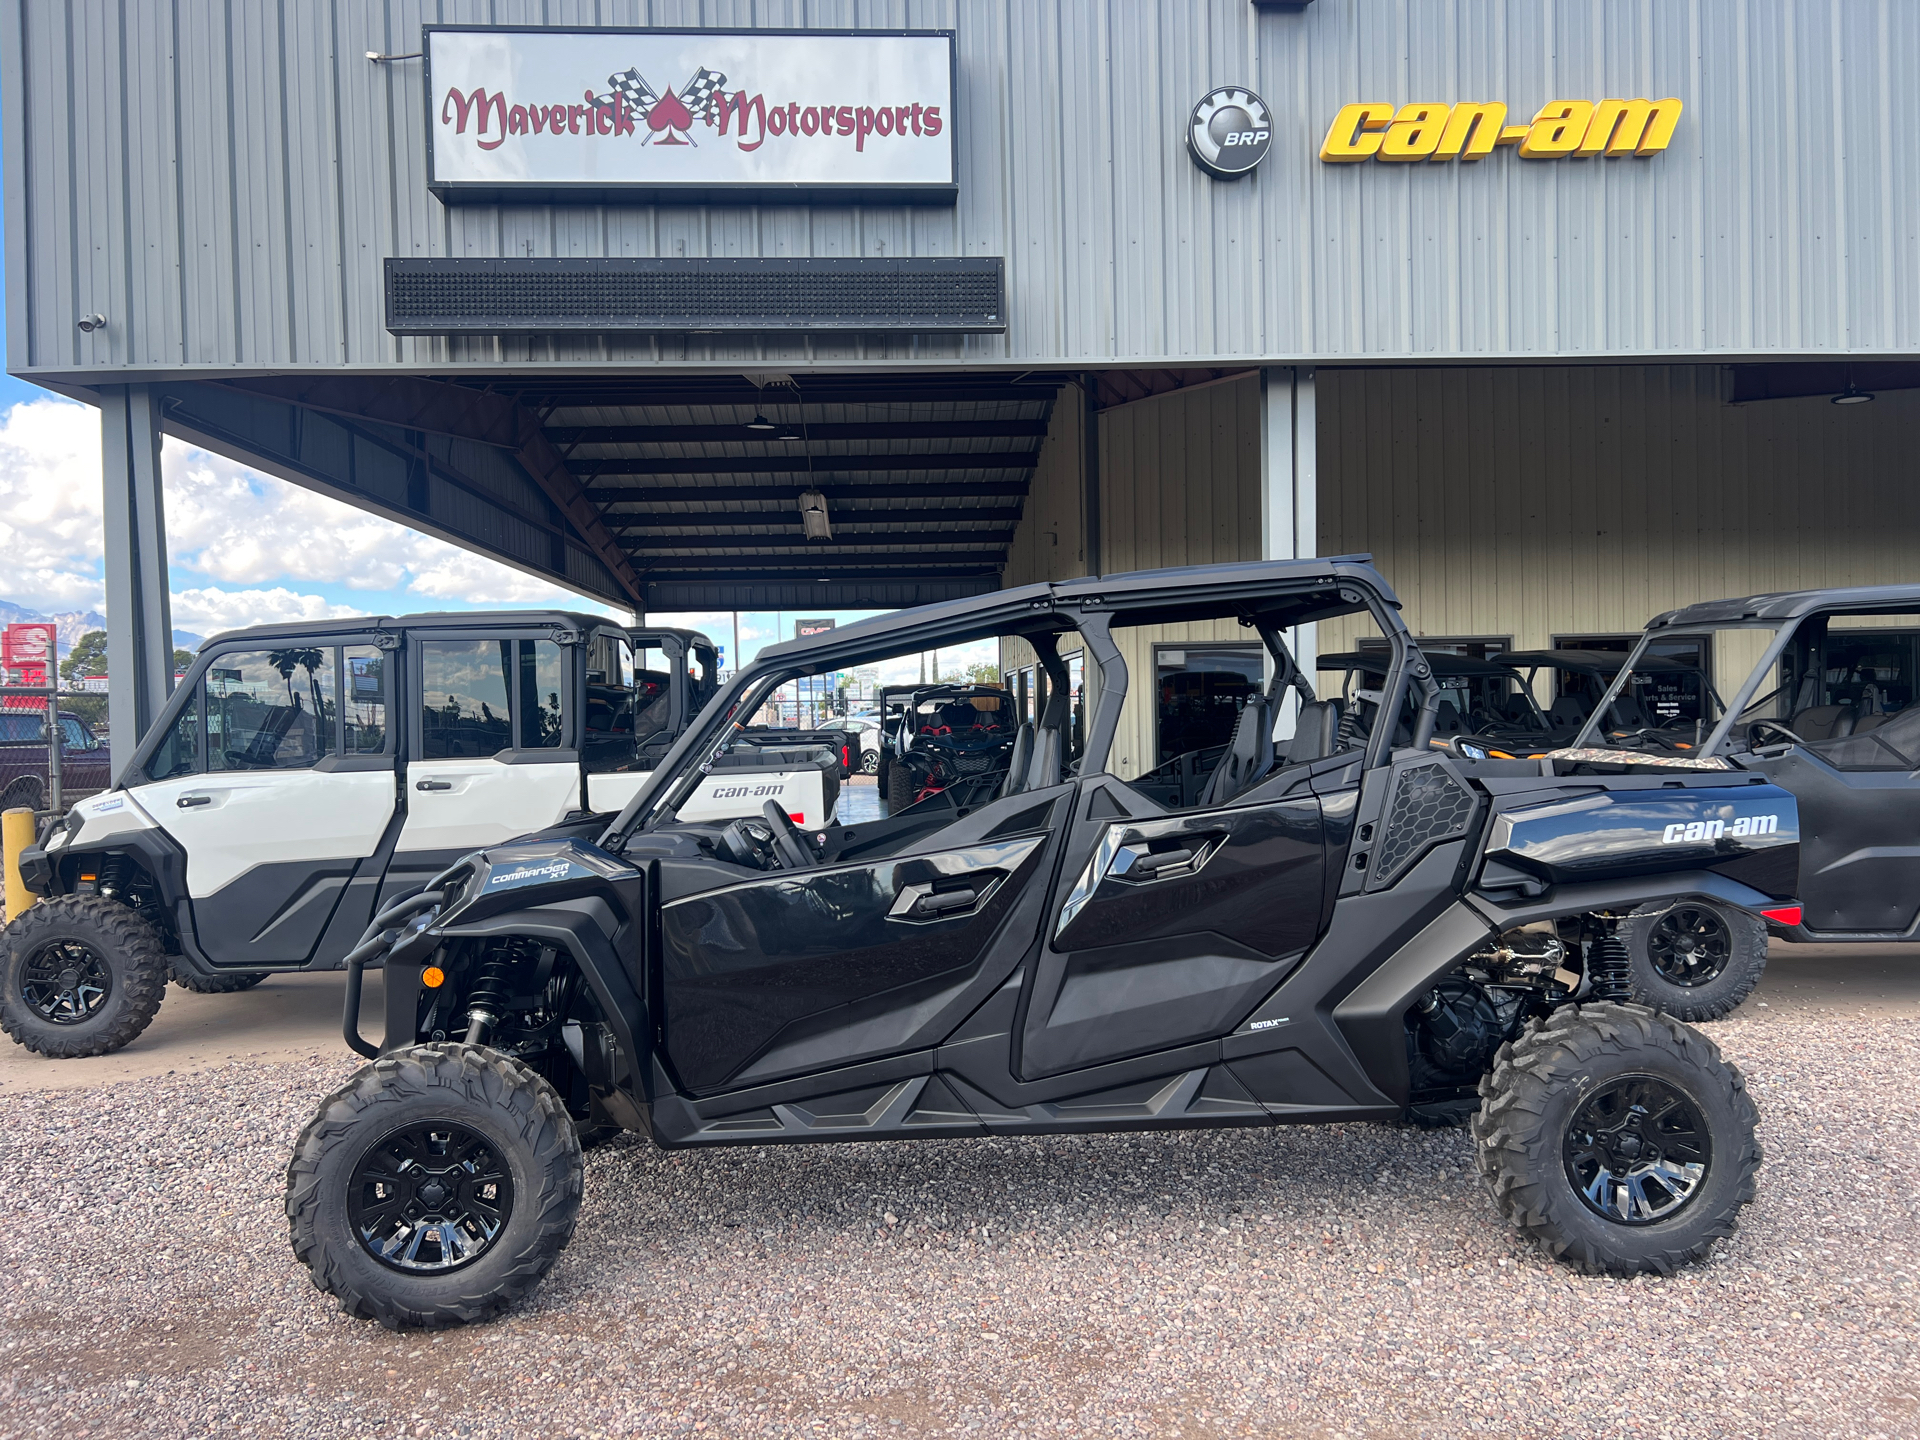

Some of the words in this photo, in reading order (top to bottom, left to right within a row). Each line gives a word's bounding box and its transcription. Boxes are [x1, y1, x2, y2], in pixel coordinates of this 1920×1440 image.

[442, 87, 636, 151] Maverick
[705, 89, 944, 153] Motorsports
[1320, 97, 1683, 163] can-am
[1223, 130, 1269, 147] BRP
[1657, 684, 1678, 692] Sales
[1660, 693, 1667, 701] &
[1668, 693, 1697, 702] Service
[712, 784, 785, 799] can-am
[1662, 814, 1779, 845] can-am
[491, 862, 570, 884] COMMANDER
[549, 870, 569, 879] XT
[1250, 1018, 1279, 1030] ROTAX
